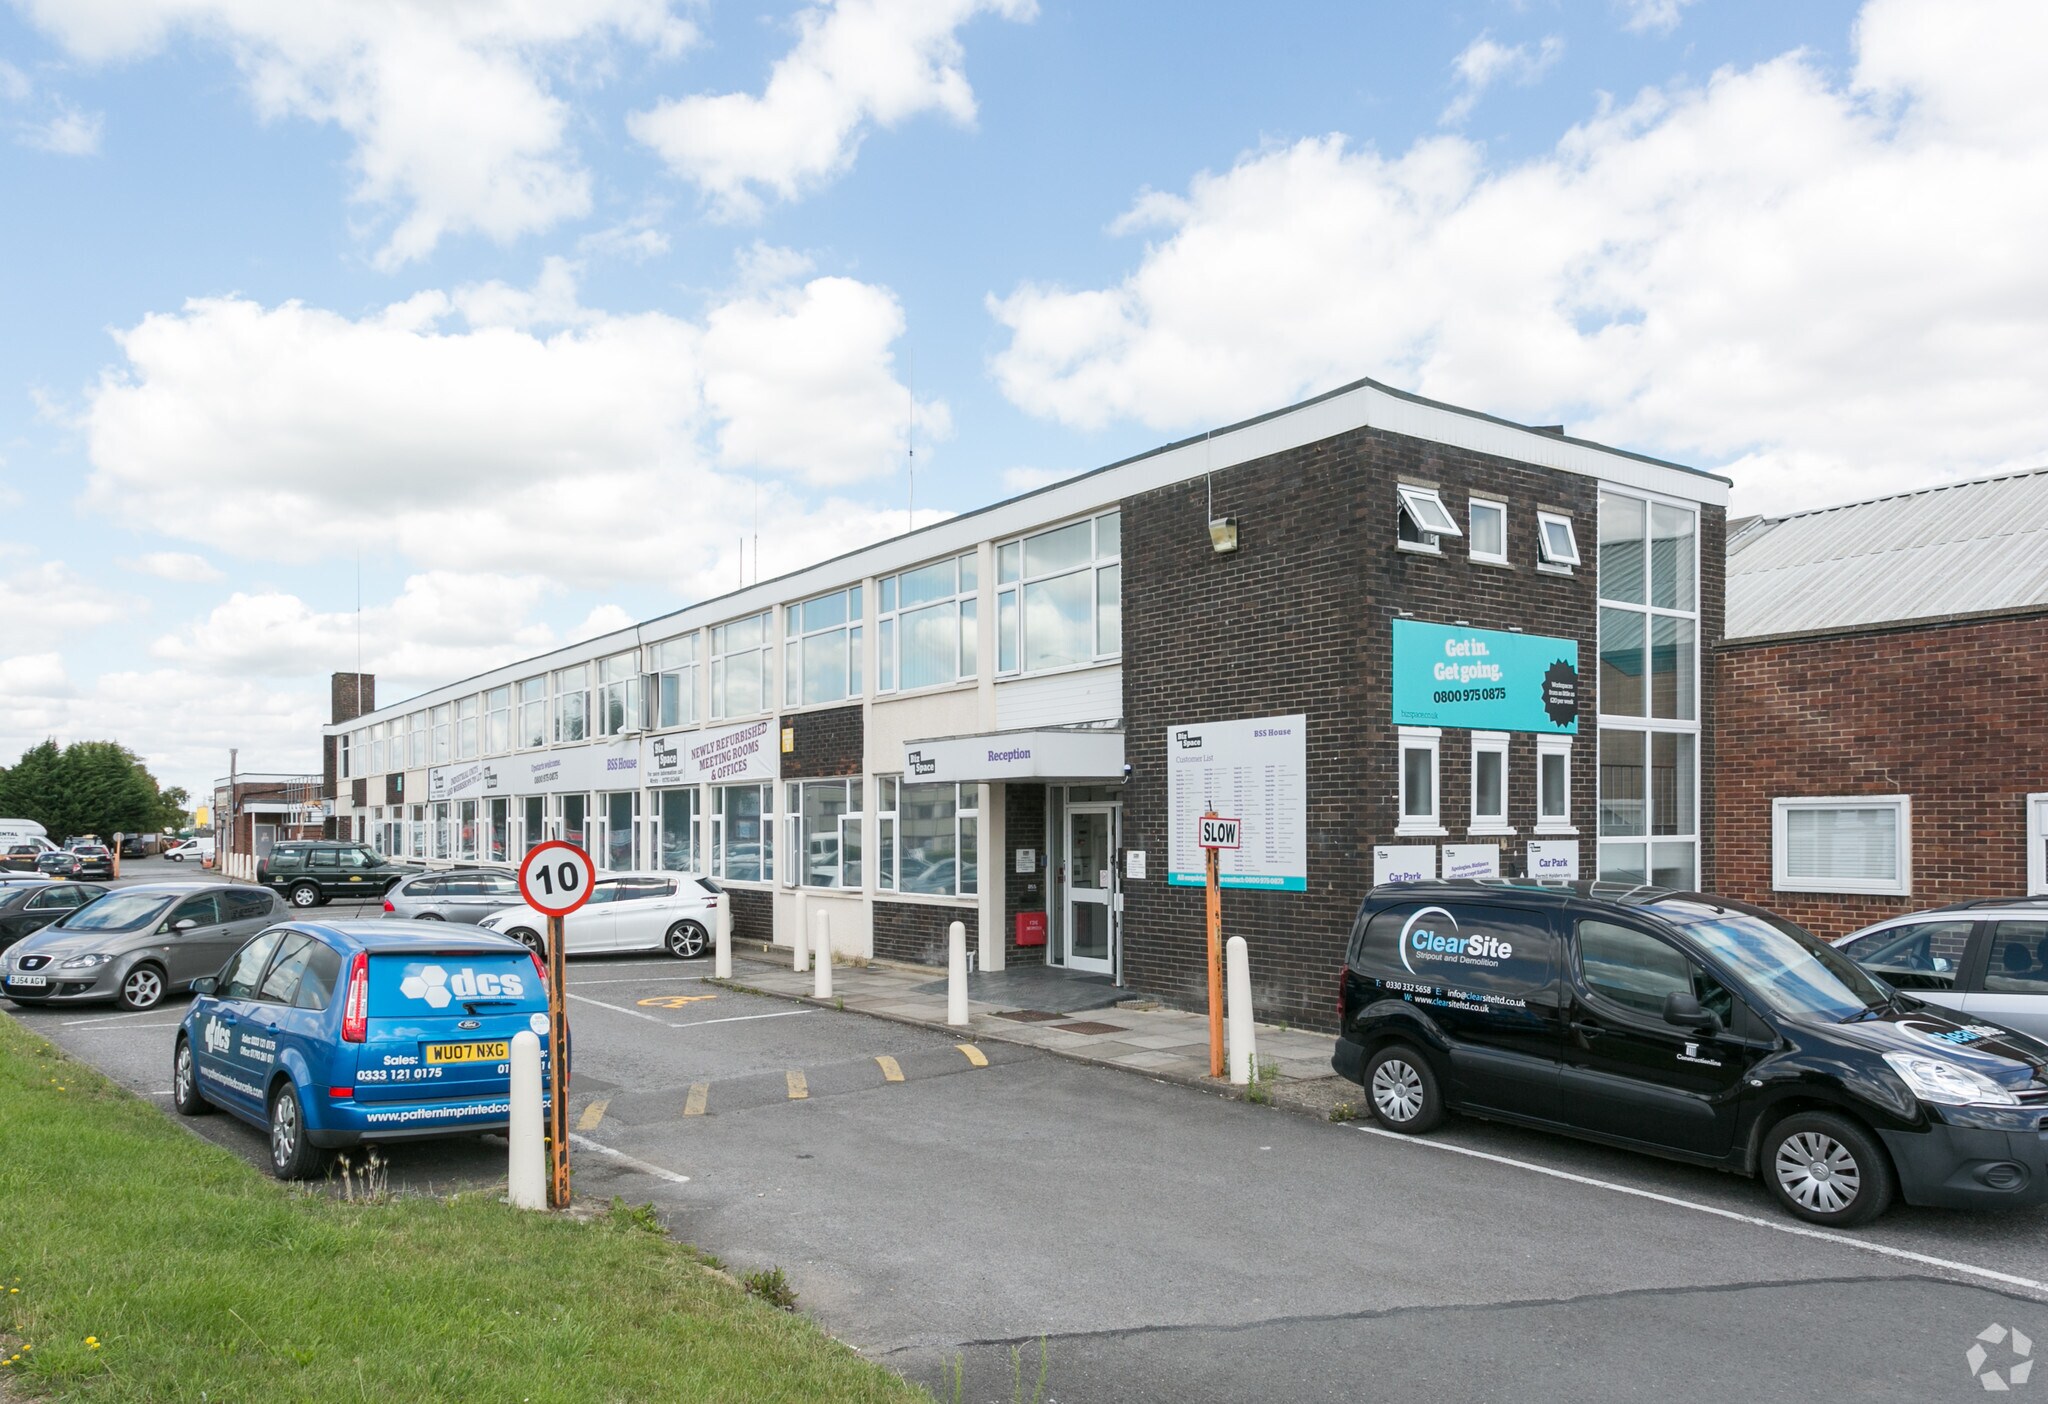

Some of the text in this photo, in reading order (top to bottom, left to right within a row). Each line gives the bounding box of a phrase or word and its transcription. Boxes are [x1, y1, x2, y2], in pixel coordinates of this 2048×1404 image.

[1445, 638, 1490, 657] Get in.
[1433, 660, 1503, 683] Get going.
[1433, 687, 1506, 703] 0800 975 0875
[1254, 728, 1291, 737] BSS House
[691, 742, 715, 760] NEWLY
[716, 722, 767, 751] REFURBISHED
[1183, 739, 1201, 748] Space
[660, 754, 677, 766] Space
[699, 750, 731, 771] MEETING
[732, 740, 759, 760] ROOMS
[988, 748, 1031, 762] Reception
[1176, 754, 1214, 764] Customer List
[607, 758, 637, 771] BSS House
[711, 759, 747, 780] & OFFICES
[915, 762, 934, 773] Space
[1204, 822, 1236, 843] SLOW
[1539, 858, 1568, 867] Car Park
[535, 861, 579, 895] 10
[1389, 872, 1422, 882] Car Park
[1412, 929, 1512, 959] ClearSite
[1416, 951, 1499, 967] Stripout and Demolition
[11, 976, 45, 985] BJ54 AGV
[451, 968, 524, 996] dcs
[1375, 979, 1382, 987] T:
[1386, 981, 1401, 990] 0330
[1402, 983, 1415, 992] 332
[1415, 985, 1431, 994] 5658
[1447, 989, 1526, 1008] info@clearsiteltd.co.uk
[1404, 993, 1489, 1013] W: www.clearsiteltd.co.uk
[214, 1021, 231, 1050] dcs
[434, 1043, 504, 1061] WU07 NXG
[383, 1055, 418, 1066] Sales:
[356, 1067, 442, 1081] 0333 121 0175
